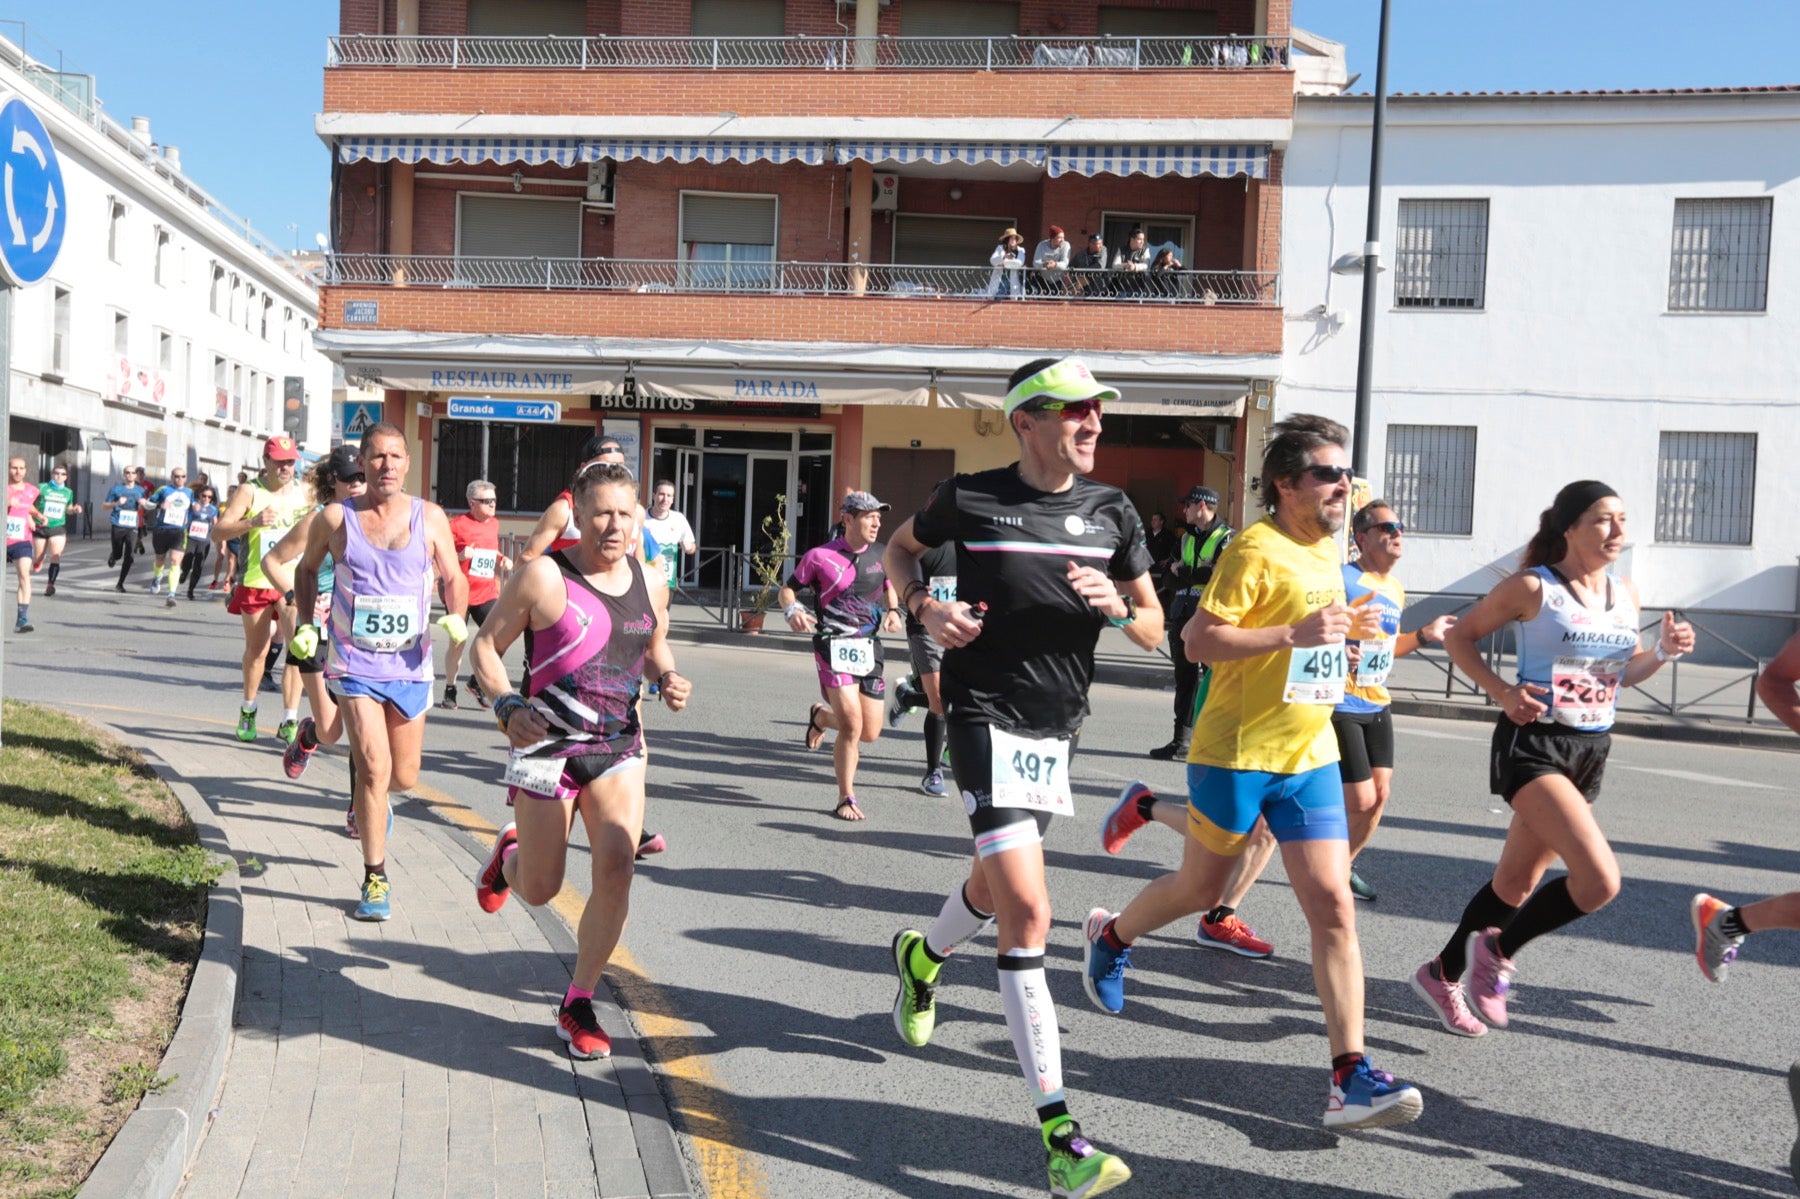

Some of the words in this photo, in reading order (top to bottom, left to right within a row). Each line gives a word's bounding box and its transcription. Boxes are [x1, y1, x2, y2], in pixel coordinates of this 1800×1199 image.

[431, 370, 573, 389] RESTAURANTE
[734, 379, 818, 398] PARADA
[451, 403, 494, 415] Granada
[476, 558, 494, 568] 590
[365, 614, 409, 634] 539
[838, 648, 866, 663] 863
[1304, 650, 1342, 678] 491
[1012, 750, 1056, 786] 497
